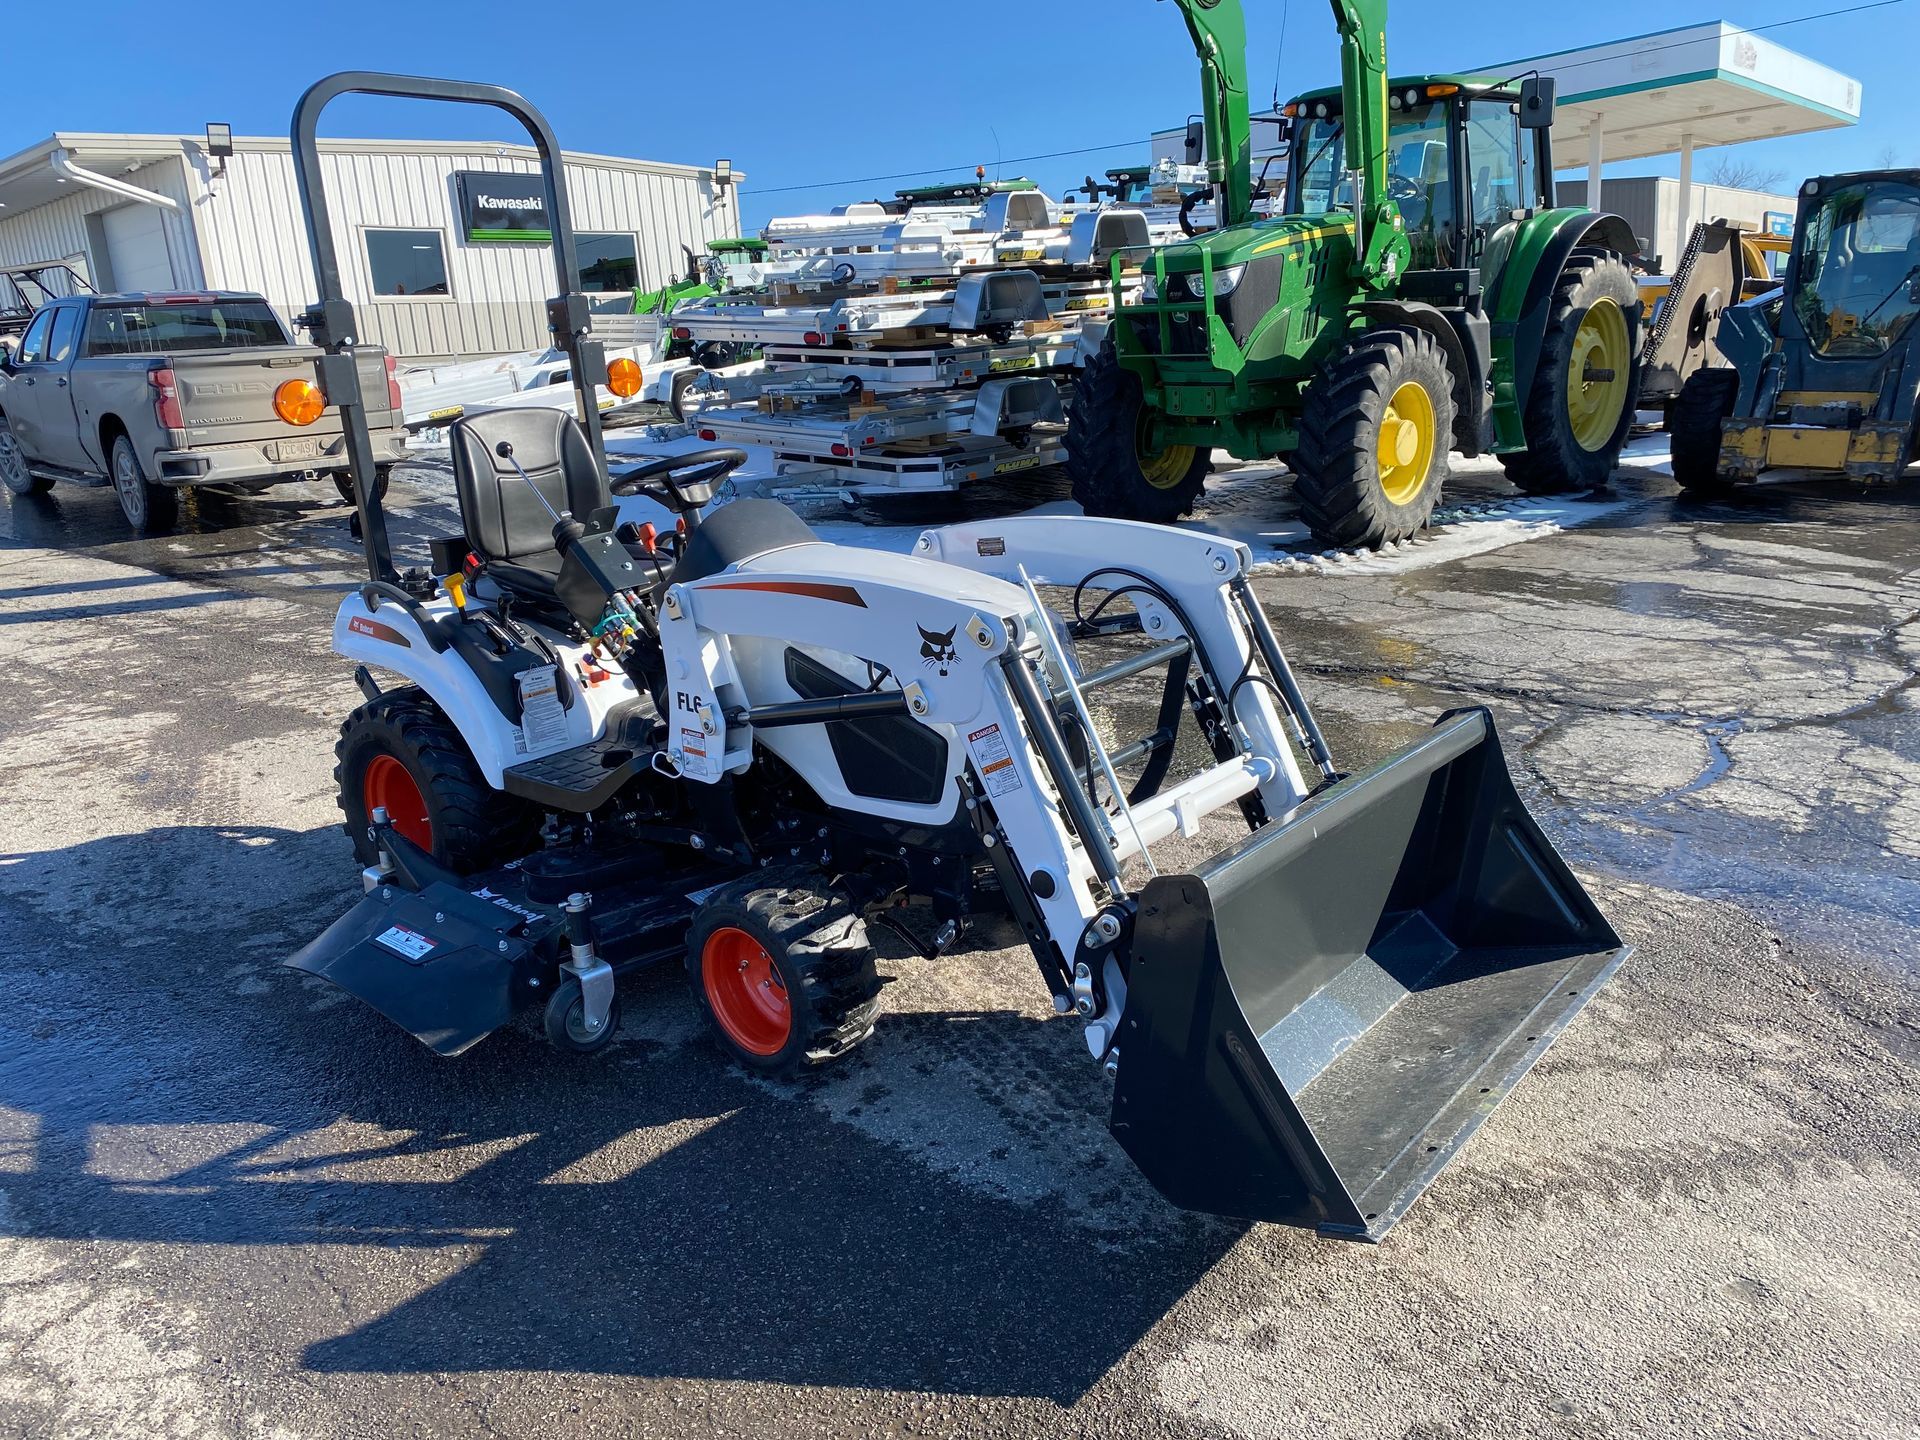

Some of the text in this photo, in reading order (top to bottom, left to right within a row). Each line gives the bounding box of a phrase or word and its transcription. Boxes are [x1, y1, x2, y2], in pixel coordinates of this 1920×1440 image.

[477, 194, 543, 210] Kawasaki
[989, 356, 1035, 371] ALUMA
[995, 456, 1039, 473] ALUMA
[676, 691, 702, 714] FL6
[976, 725, 997, 739] DANGER
